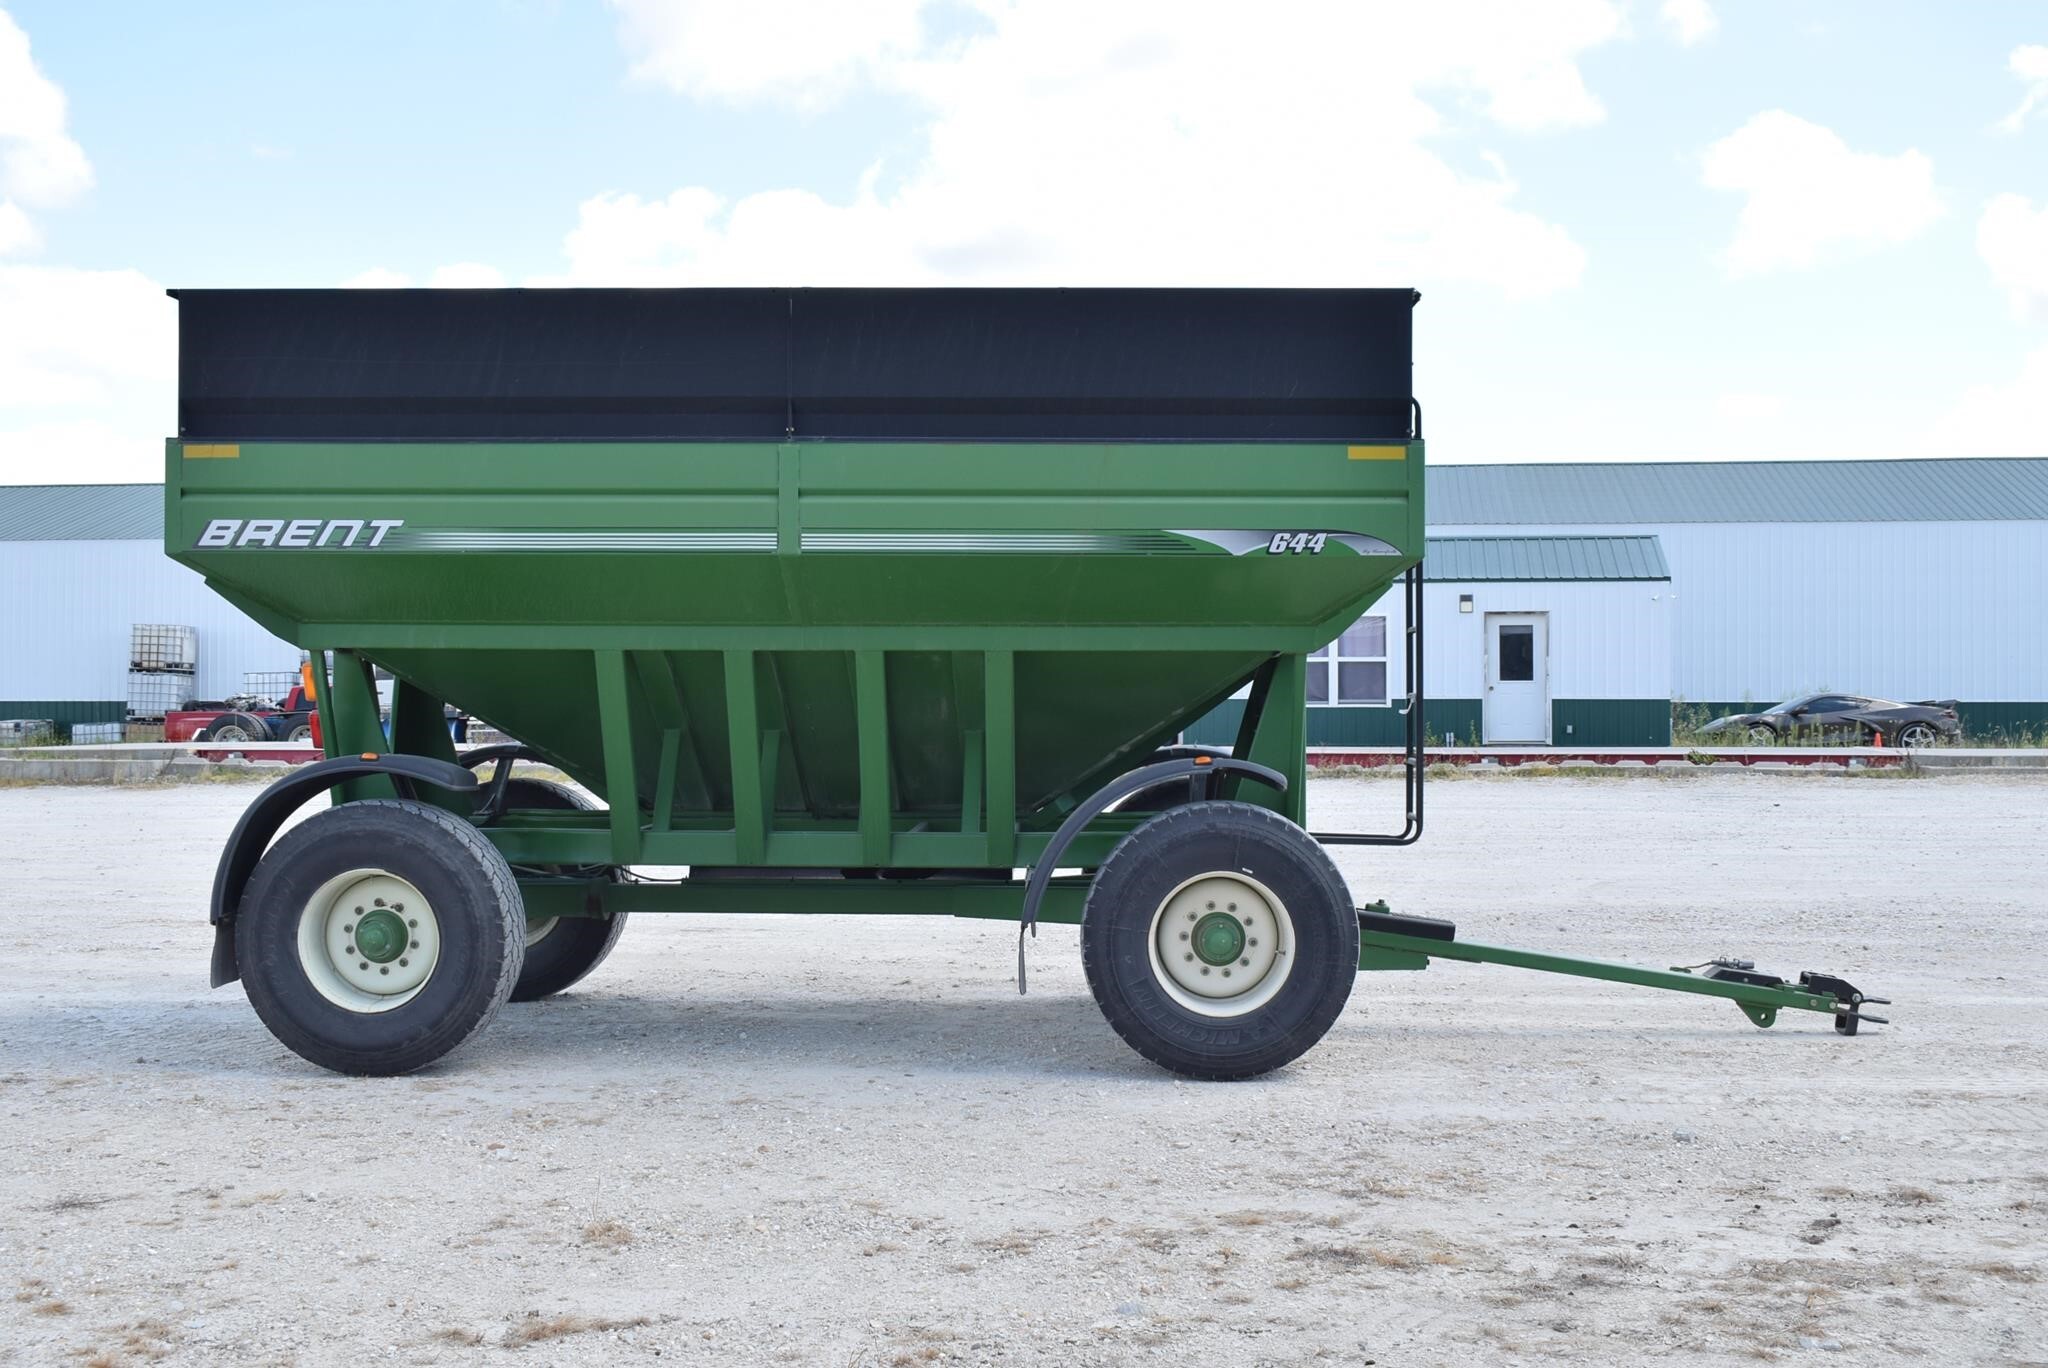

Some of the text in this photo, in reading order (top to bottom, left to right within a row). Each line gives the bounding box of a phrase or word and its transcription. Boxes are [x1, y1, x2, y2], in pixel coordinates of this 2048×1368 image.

[195, 519, 404, 547] BRENT
[1267, 532, 1328, 554] 644
[1132, 987, 1241, 1045] MICHELIN
